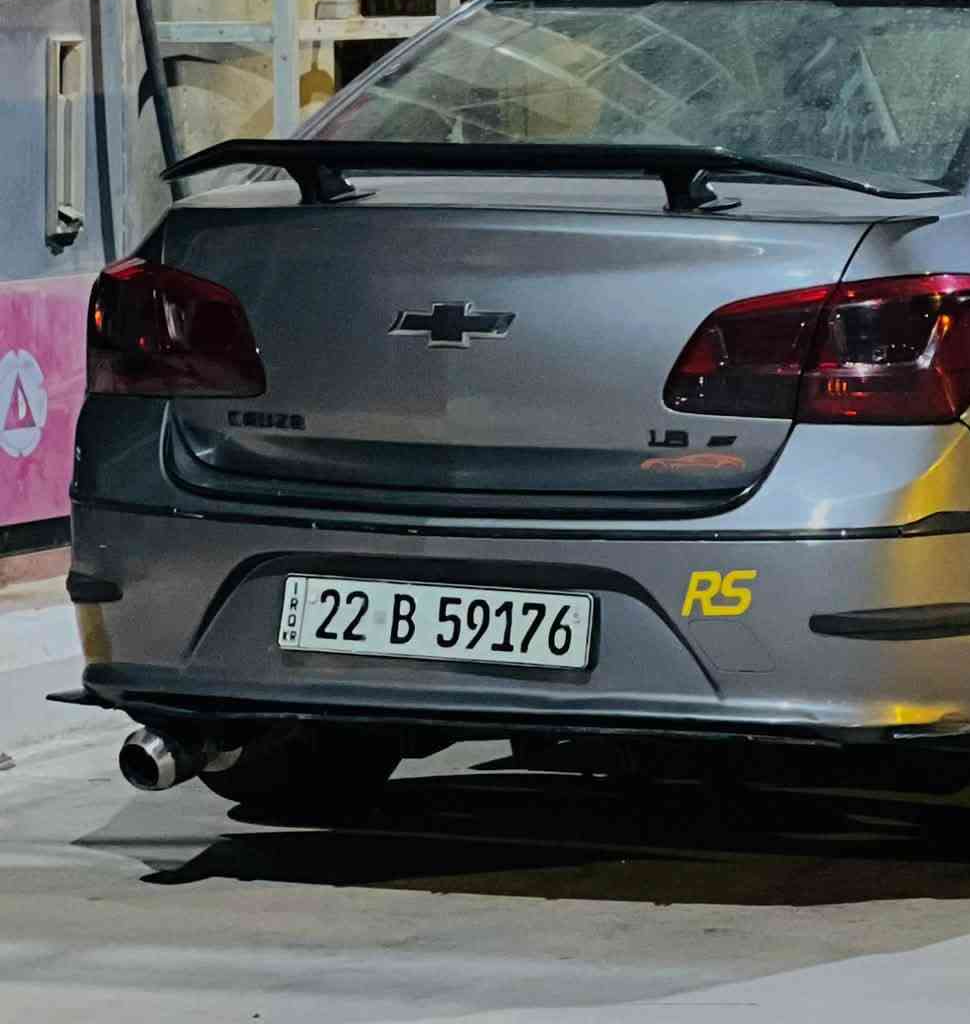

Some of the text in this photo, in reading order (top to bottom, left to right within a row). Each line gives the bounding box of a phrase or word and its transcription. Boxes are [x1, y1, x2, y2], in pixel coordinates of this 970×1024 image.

[314, 588, 574, 656] 22 B 59176
[681, 569, 757, 617] RS
